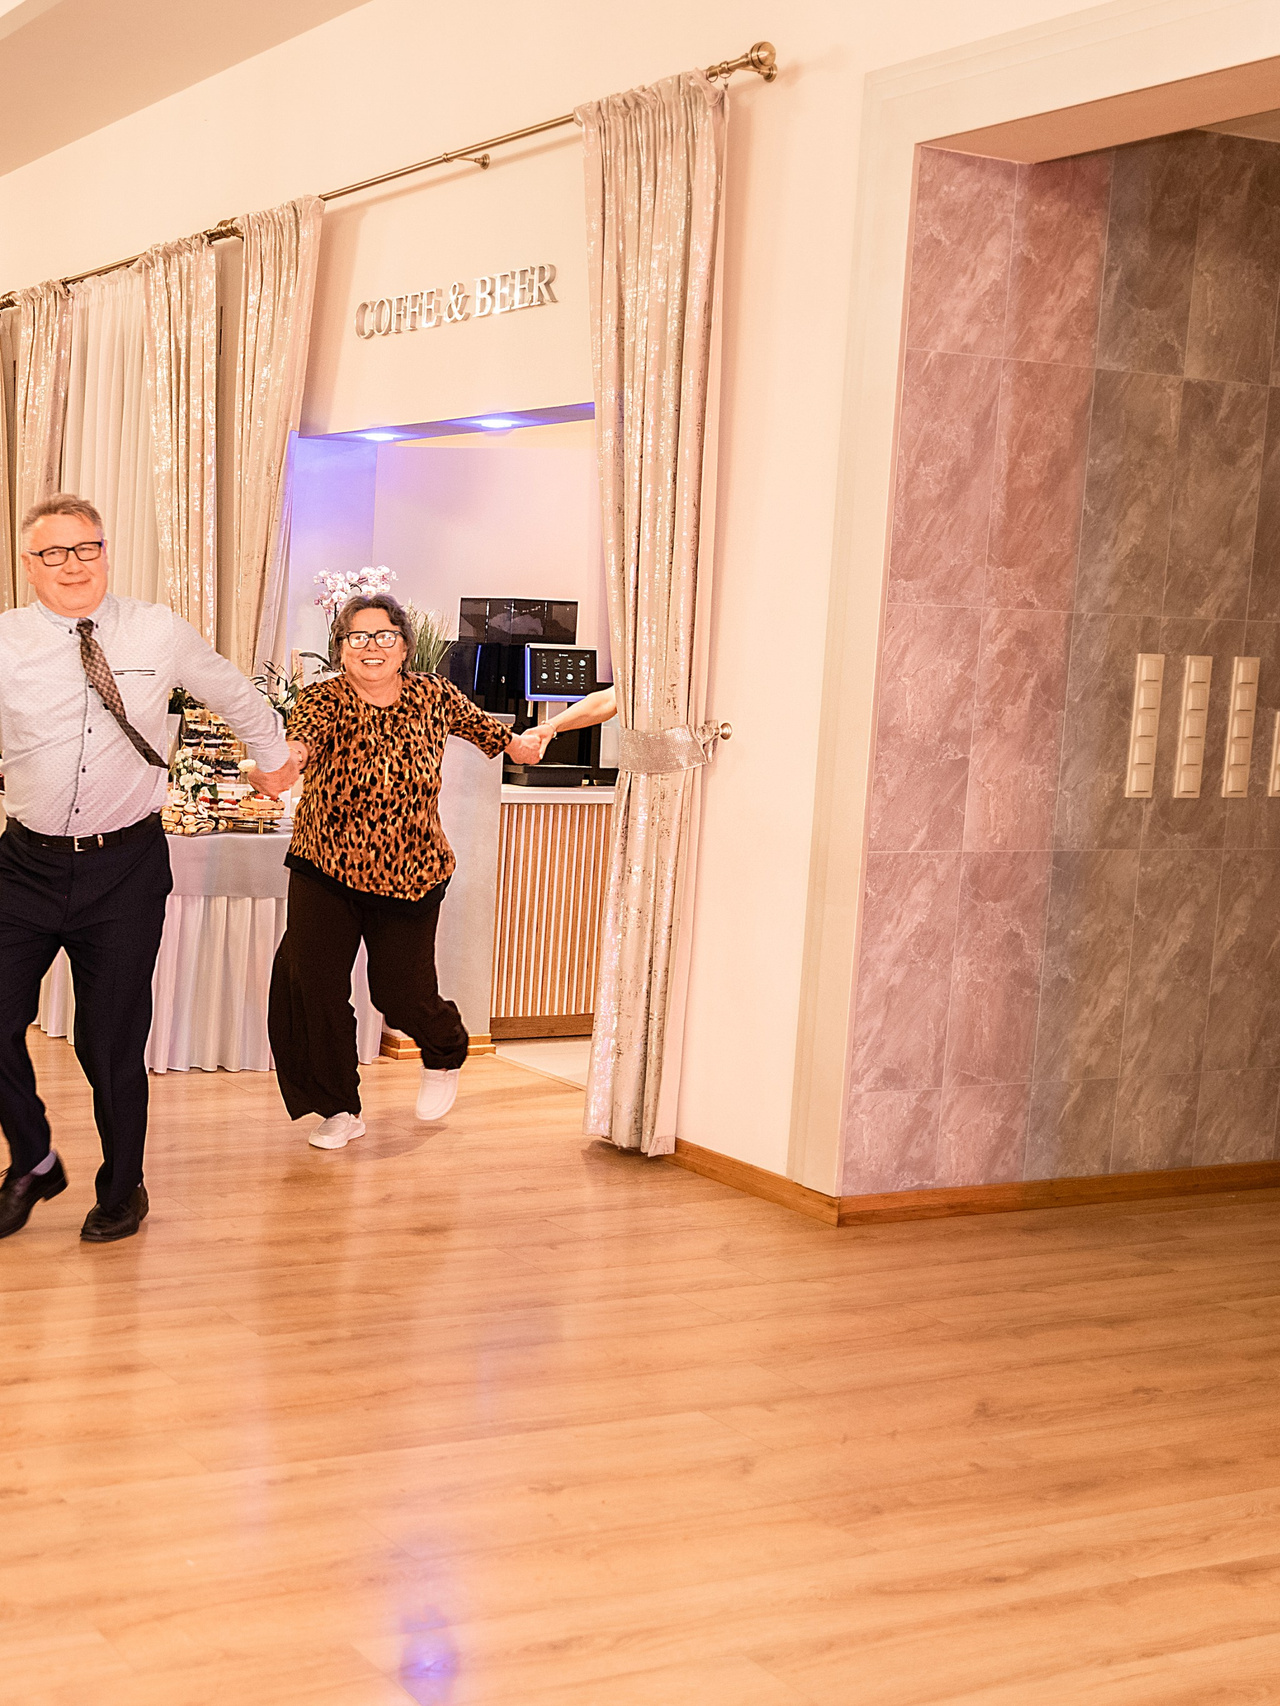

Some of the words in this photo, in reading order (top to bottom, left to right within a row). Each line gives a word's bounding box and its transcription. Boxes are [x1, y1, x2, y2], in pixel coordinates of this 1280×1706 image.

[354, 288, 443, 339] COFFE
[443, 281, 470, 323] &
[472, 263, 558, 317] BEER
